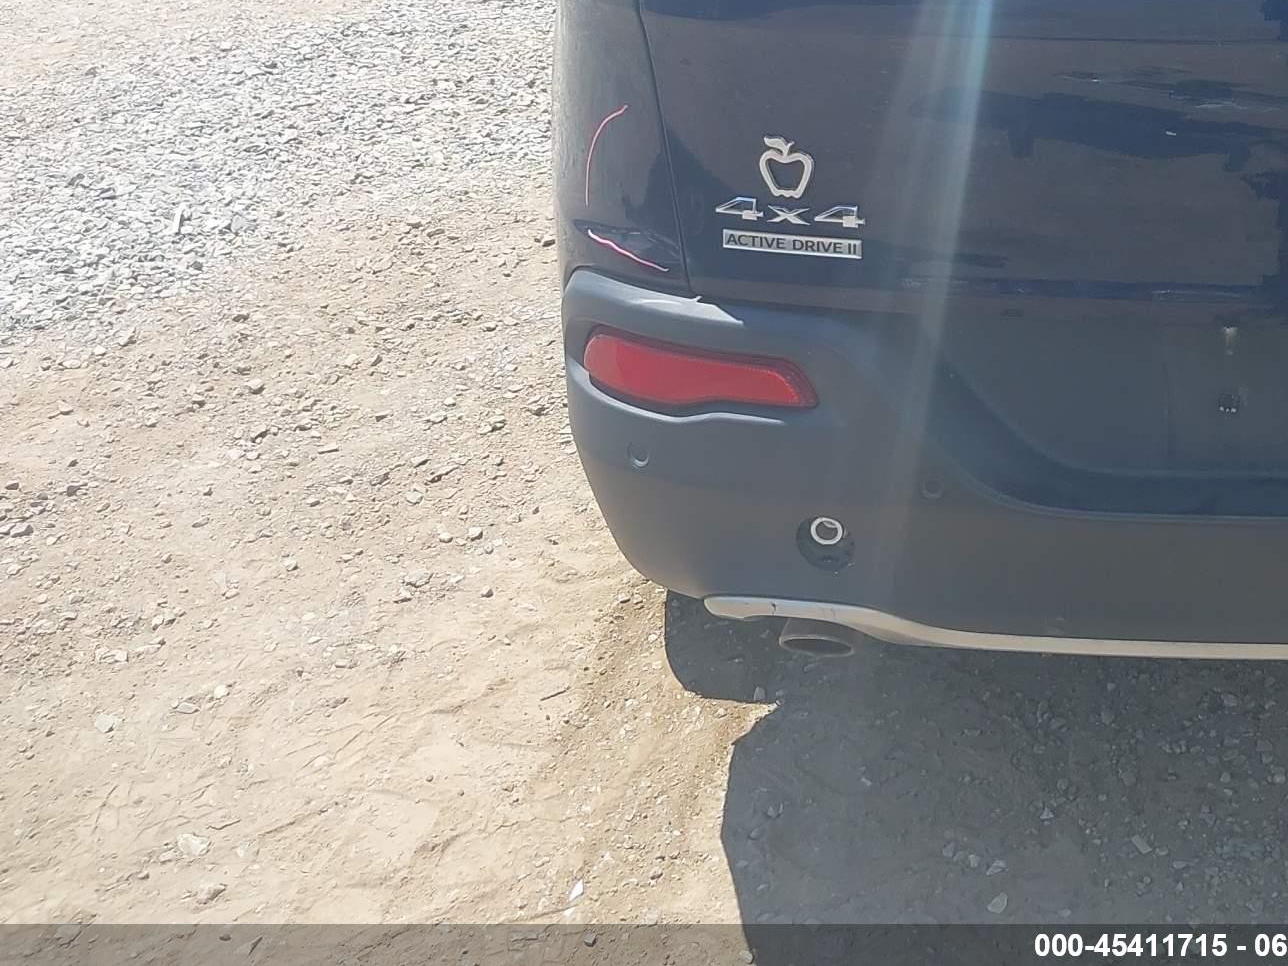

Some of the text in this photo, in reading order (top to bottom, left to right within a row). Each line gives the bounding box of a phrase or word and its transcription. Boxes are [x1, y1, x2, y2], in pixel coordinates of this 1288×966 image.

[725, 233, 858, 255] ACTIVE DRIVE II
